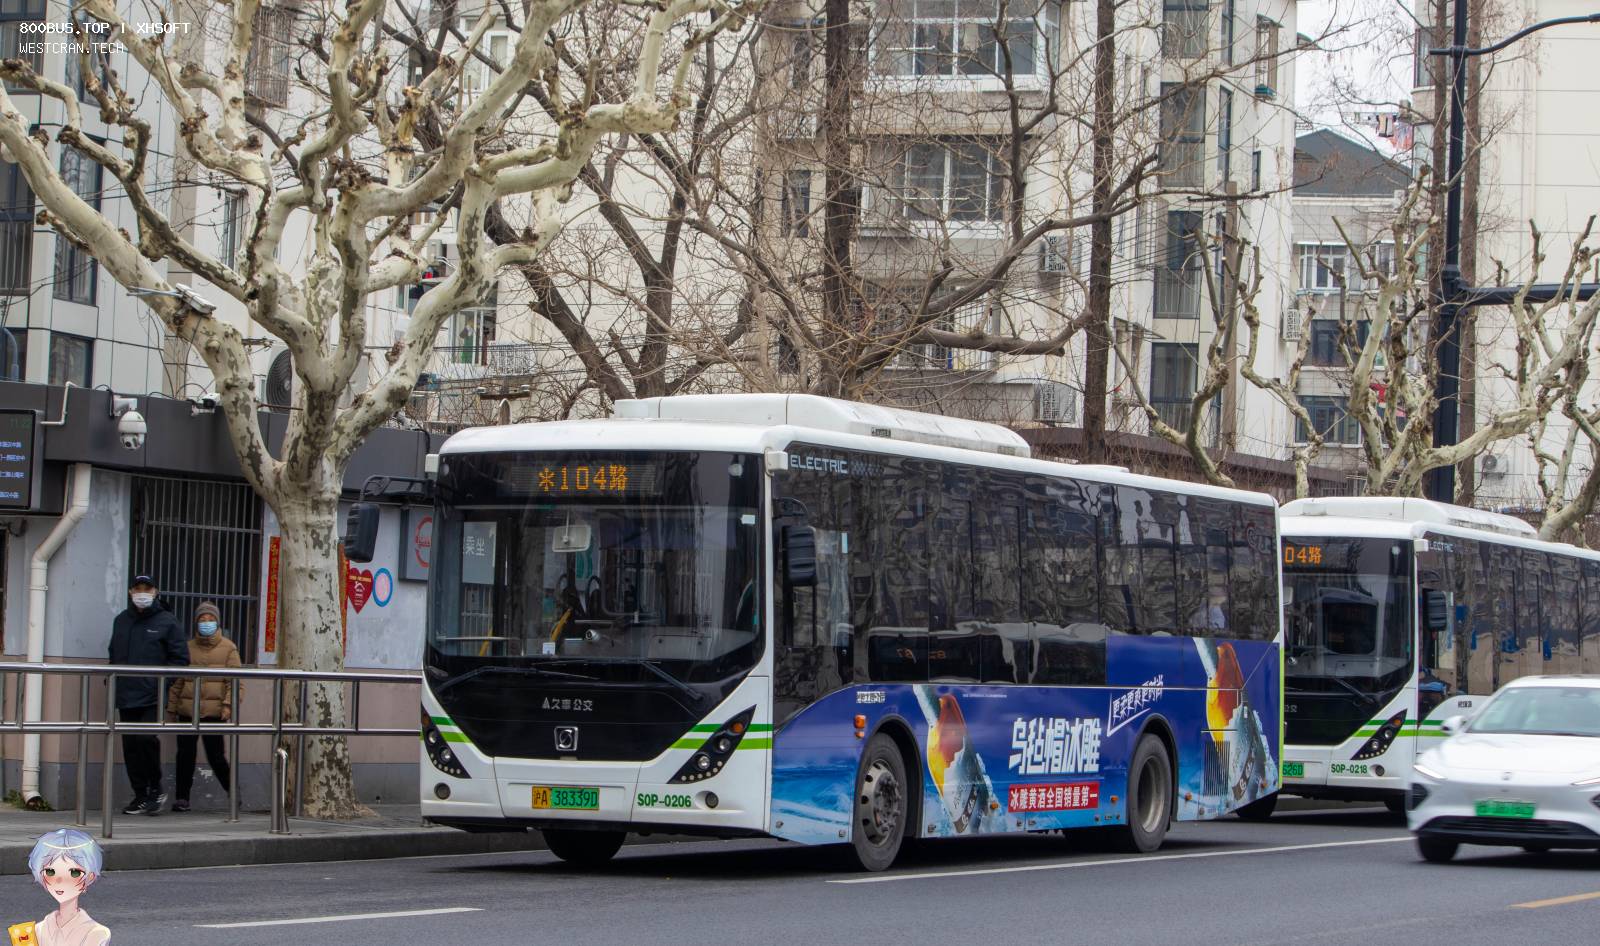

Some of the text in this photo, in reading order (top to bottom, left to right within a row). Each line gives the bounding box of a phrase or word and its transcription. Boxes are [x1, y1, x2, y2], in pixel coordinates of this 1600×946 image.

[790, 454, 848, 474] ELECTRIC
[1008, 717, 1102, 776] 乌毡帽冰雕
[1331, 763, 1368, 774] SOP-0218
[637, 793, 692, 808] SOP-0206
[1009, 785, 1098, 810] 冰雕黄酒全国销量第一
